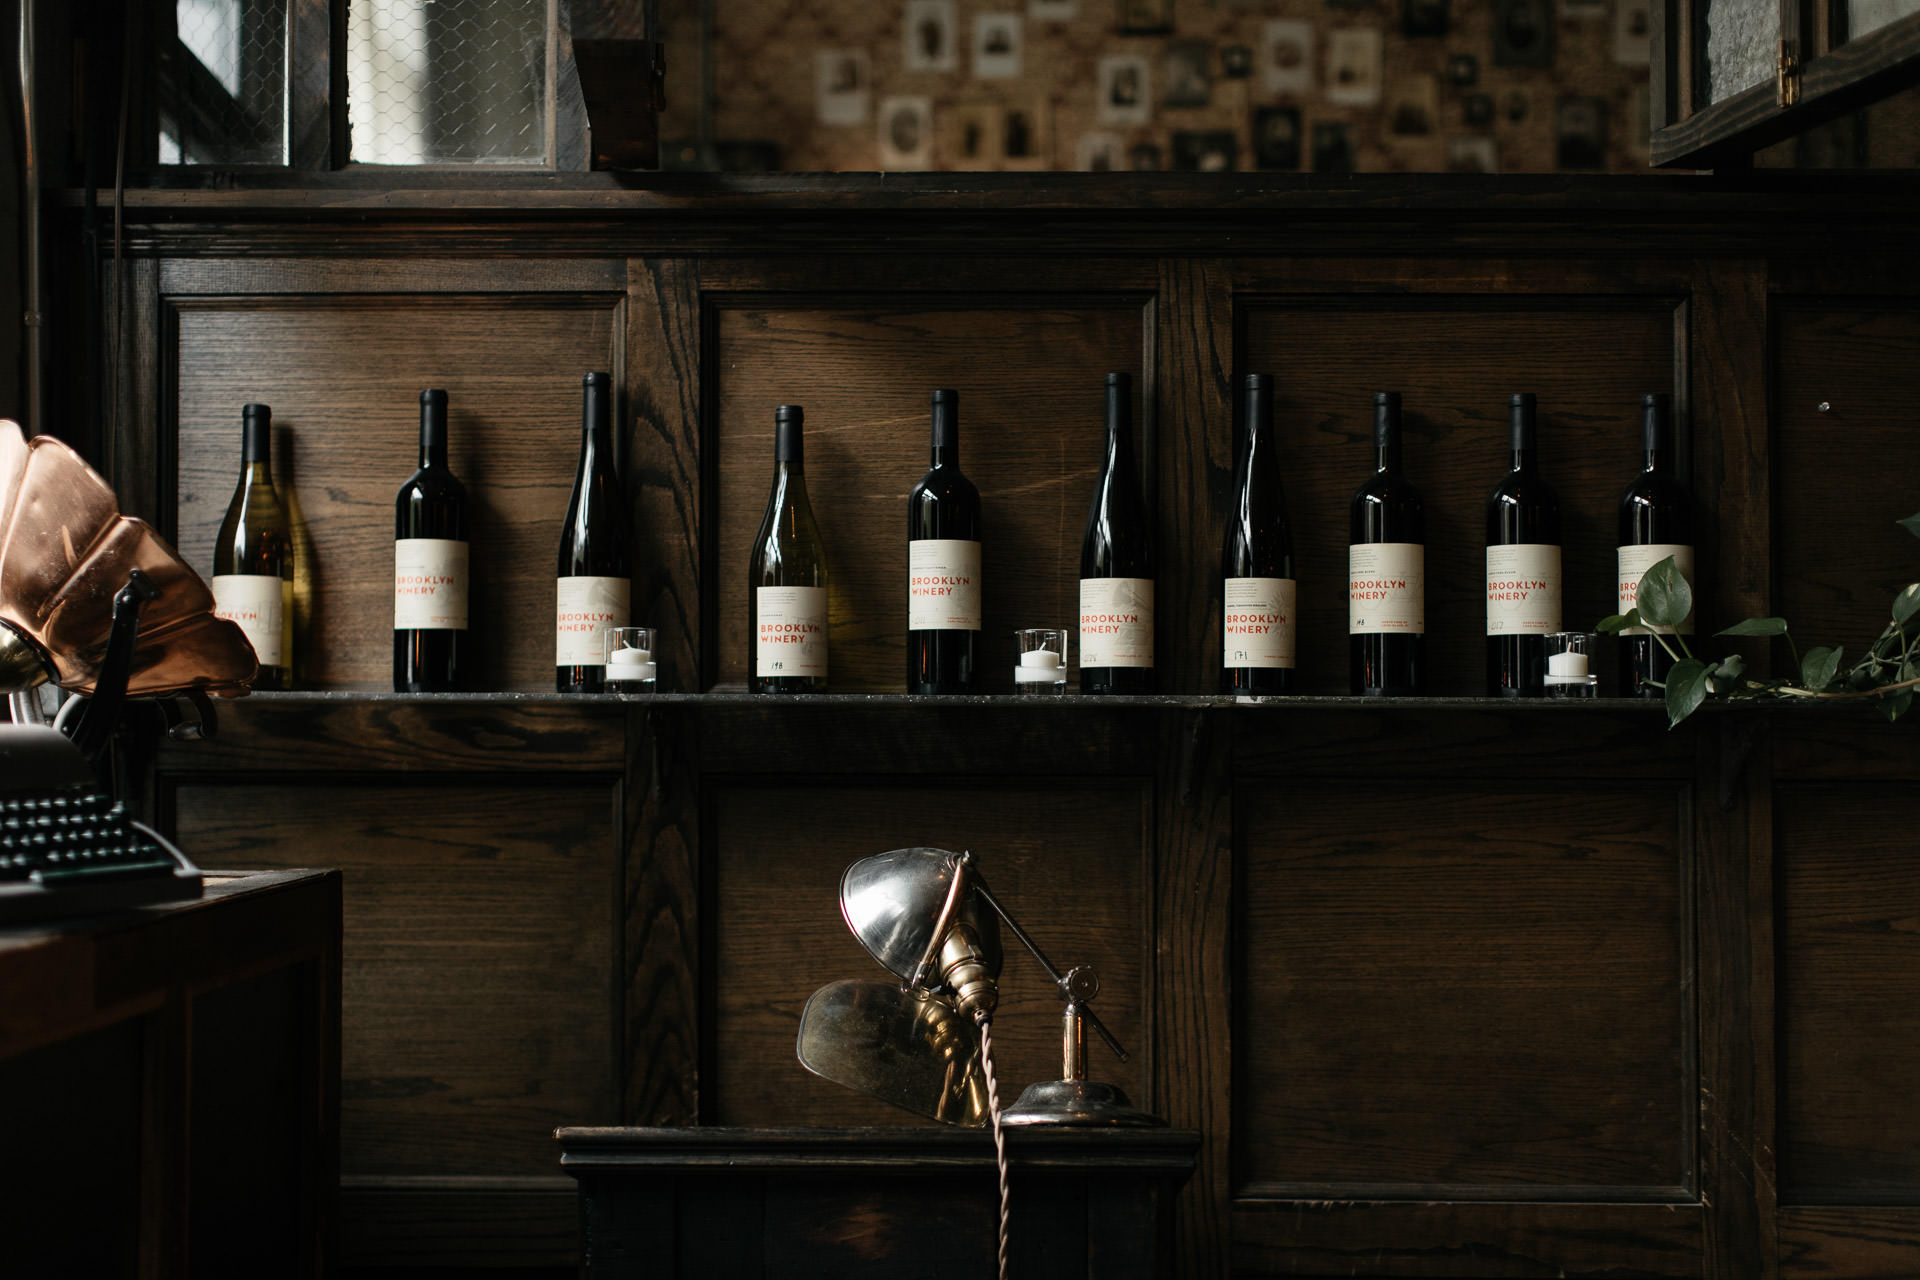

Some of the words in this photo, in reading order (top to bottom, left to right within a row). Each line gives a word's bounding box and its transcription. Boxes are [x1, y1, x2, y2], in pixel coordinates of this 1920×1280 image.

[911, 576, 970, 586] BROOKLYN
[1350, 580, 1406, 590] BROOKLYN
[1488, 581, 1547, 591] BROOKLYN
[911, 587, 953, 596] WINERY
[1350, 591, 1387, 600] WINERY
[1488, 592, 1528, 601] WINERY
[1620, 592, 1637, 601] WIN
[1081, 614, 1138, 623] BROOKLYN
[1226, 614, 1287, 624] BROOKLYN
[760, 624, 820, 633] BROOKLYN
[1081, 625, 1120, 634] WINERY
[1226, 625, 1270, 634] WINERY
[760, 635, 806, 643] WINERY
